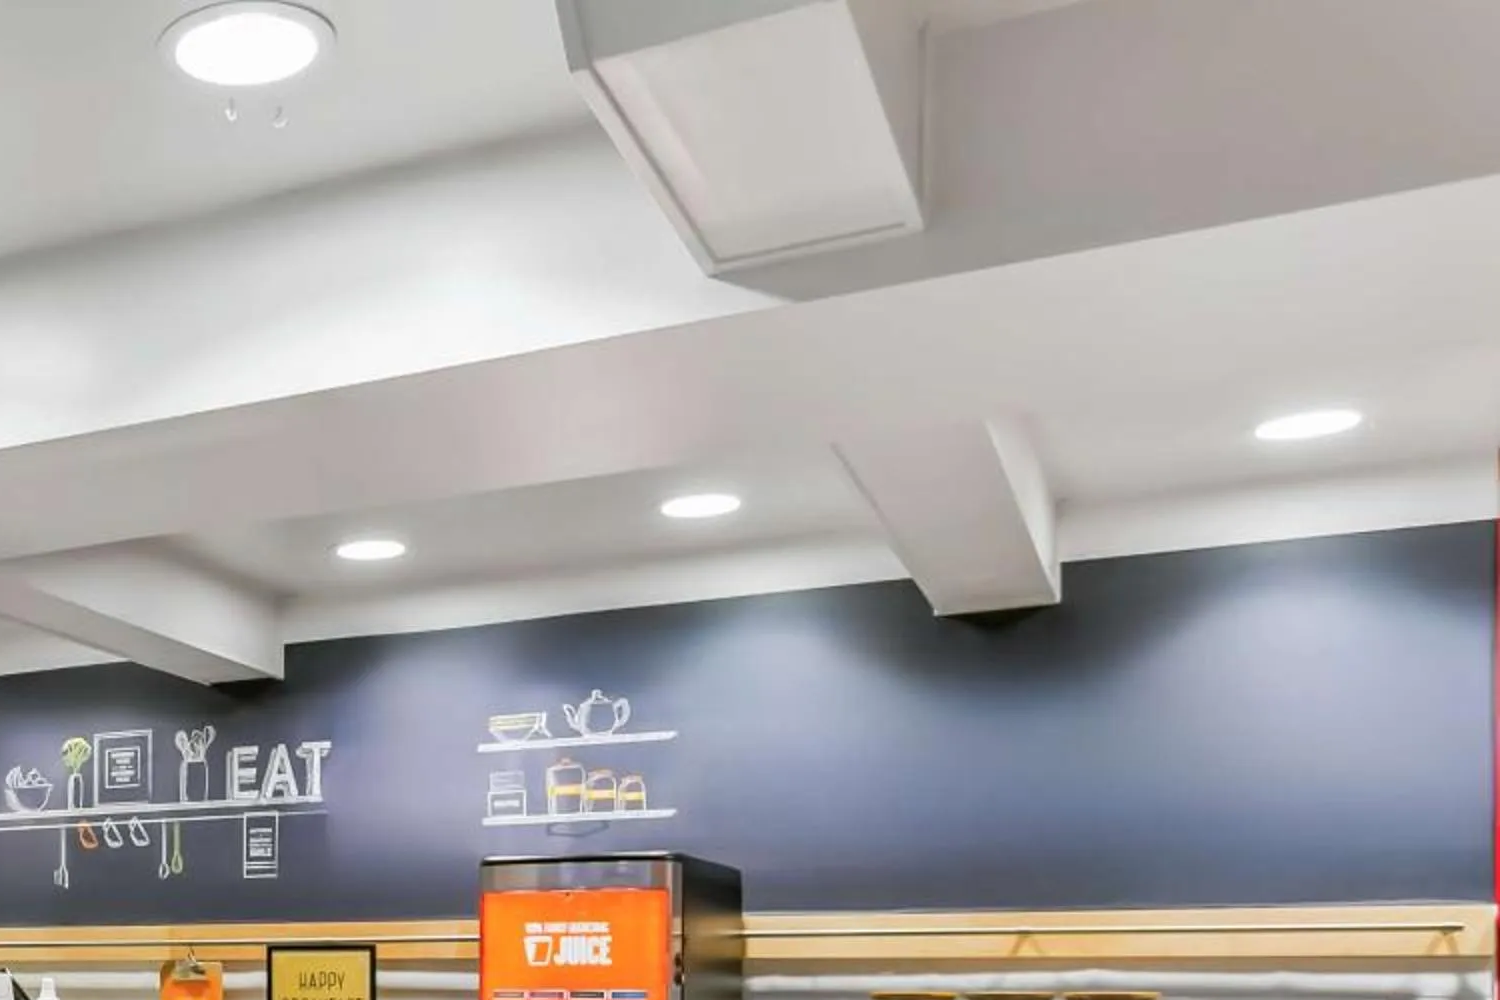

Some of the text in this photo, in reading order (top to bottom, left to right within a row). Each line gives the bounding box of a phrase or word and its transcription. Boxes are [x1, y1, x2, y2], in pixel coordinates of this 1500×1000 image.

[227, 741, 332, 801] EAT
[554, 935, 613, 966] JUICE
[299, 971, 346, 990] HAPPY
